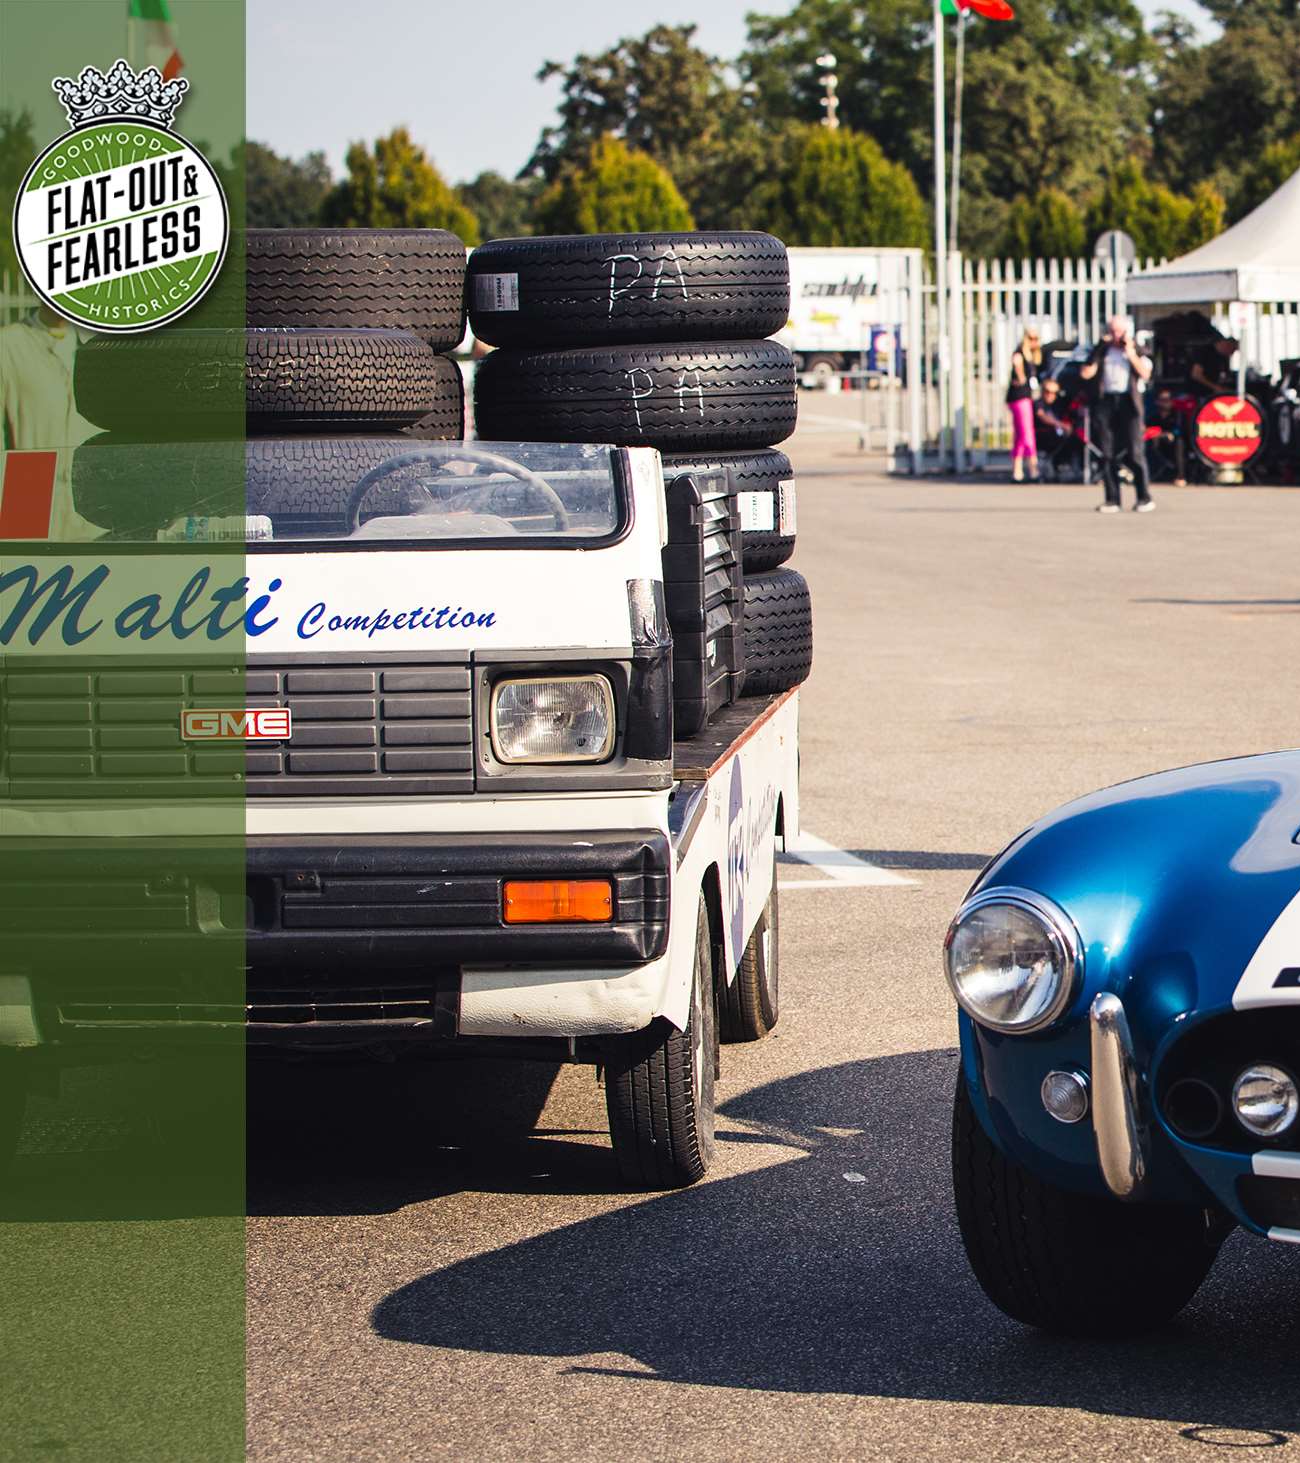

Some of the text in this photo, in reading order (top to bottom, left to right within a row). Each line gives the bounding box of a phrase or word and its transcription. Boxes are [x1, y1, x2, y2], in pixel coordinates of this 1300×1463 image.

[1198, 421, 1259, 439] MOTUL
[0, 564, 497, 646] Malti Competition
[186, 712, 289, 737] GME
